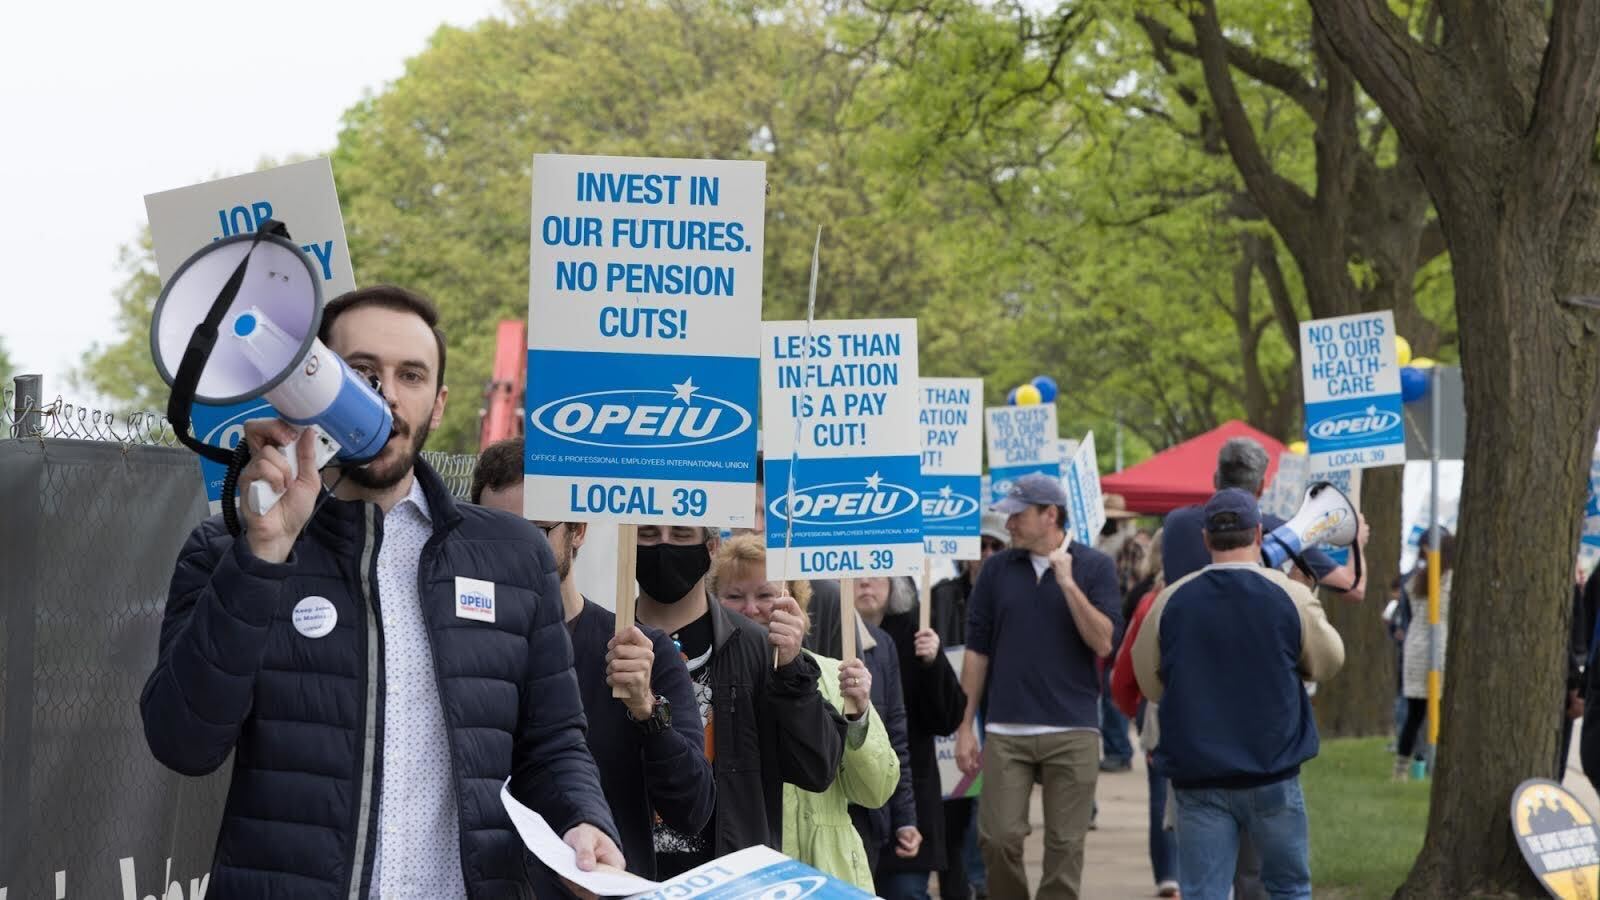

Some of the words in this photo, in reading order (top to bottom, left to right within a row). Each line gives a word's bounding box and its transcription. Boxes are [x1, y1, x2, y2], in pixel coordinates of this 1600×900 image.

[577, 172, 681, 205] INVEST
[690, 176, 719, 206] IN
[542, 215, 603, 247] OUR
[612, 218, 751, 252] FUTURES.
[556, 261, 597, 291] NO
[607, 262, 734, 296] PENSION
[600, 306, 687, 339] CUTS!
[1308, 325, 1333, 344] NO
[1339, 318, 1385, 340] CUTS
[774, 335, 832, 359] LESS
[838, 333, 901, 357] THAN
[1316, 342, 1338, 361] TO
[1344, 338, 1381, 357] OUR
[778, 363, 898, 389] INFLATION
[1312, 356, 1387, 379] HEALTH-
[925, 388, 970, 405] THAN
[1328, 375, 1375, 396] CARE
[792, 394, 814, 418] IS
[820, 394, 837, 417] A
[844, 393, 887, 416] PAY
[919, 409, 967, 425] ATION
[992, 411, 1010, 424] NO
[1015, 409, 1049, 422] CUTS
[553, 402, 722, 438] OPEIU
[1318, 414, 1388, 437] OPEIU
[814, 423, 866, 447] CUT!
[927, 430, 958, 446] PAY
[531, 453, 556, 462] OFFICE
[564, 456, 619, 464] PROFESSIONAL
[621, 457, 665, 466] EMPLOYEES
[666, 459, 723, 468] INTERNATIONAL
[724, 461, 749, 469] UNION
[1328, 451, 1365, 467] LOCAL
[1370, 449, 1385, 461] 39
[571, 484, 663, 515] LOCAL
[672, 488, 707, 517] 39
[785, 491, 900, 518] OPEIU
[921, 499, 965, 516] EIU
[940, 540, 957, 554] 39
[800, 550, 864, 573] LOCAL
[869, 549, 894, 570] 39
[460, 594, 492, 609] OPEIU
